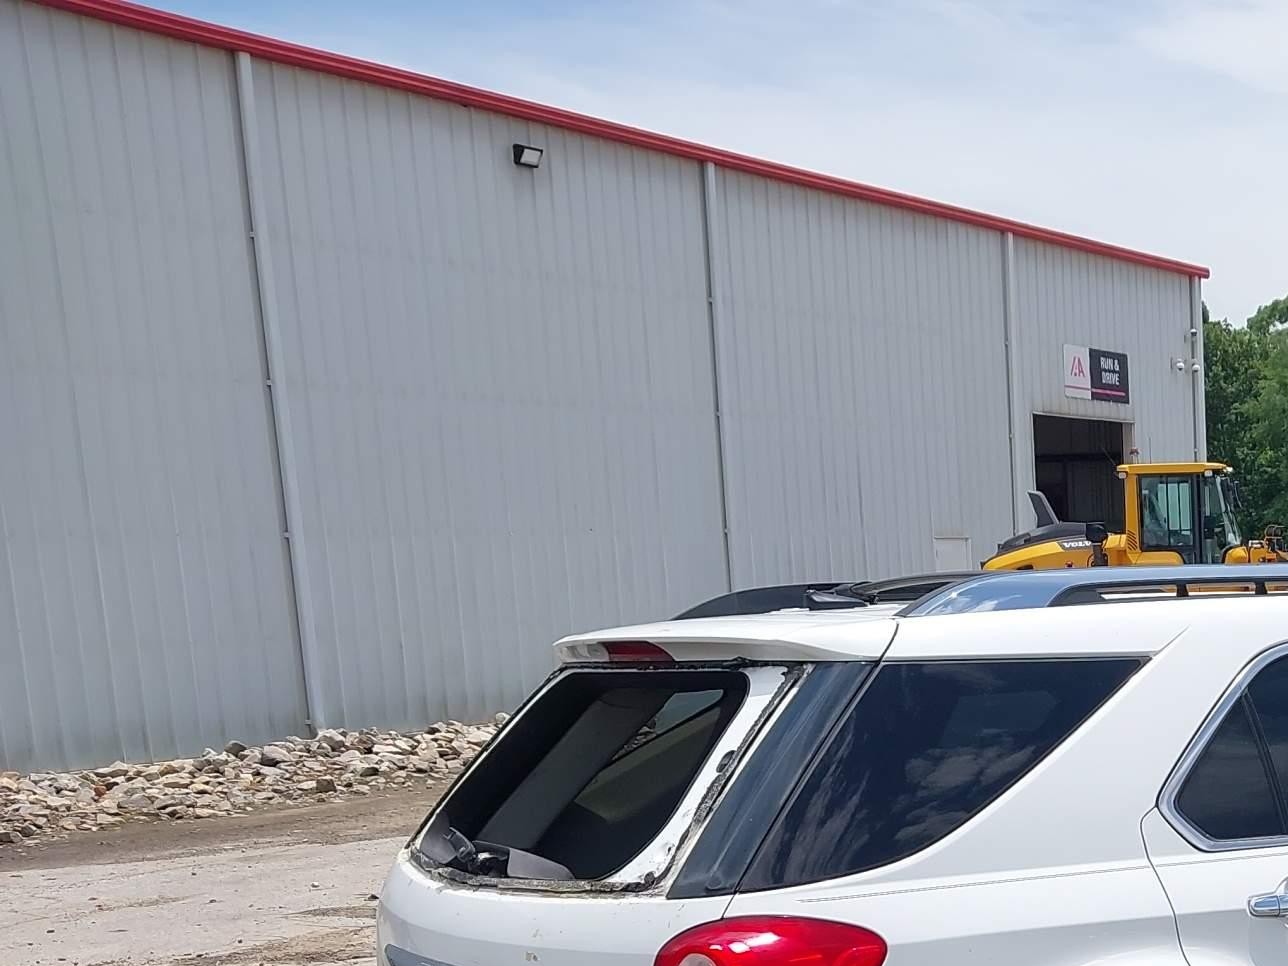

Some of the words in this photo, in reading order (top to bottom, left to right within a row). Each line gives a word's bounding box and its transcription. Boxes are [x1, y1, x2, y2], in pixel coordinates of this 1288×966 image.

[1100, 356, 1113, 371] RUN
[1113, 359, 1120, 371] &
[1101, 371, 1120, 386] DRIVE
[1062, 540, 1092, 548] VOLV
